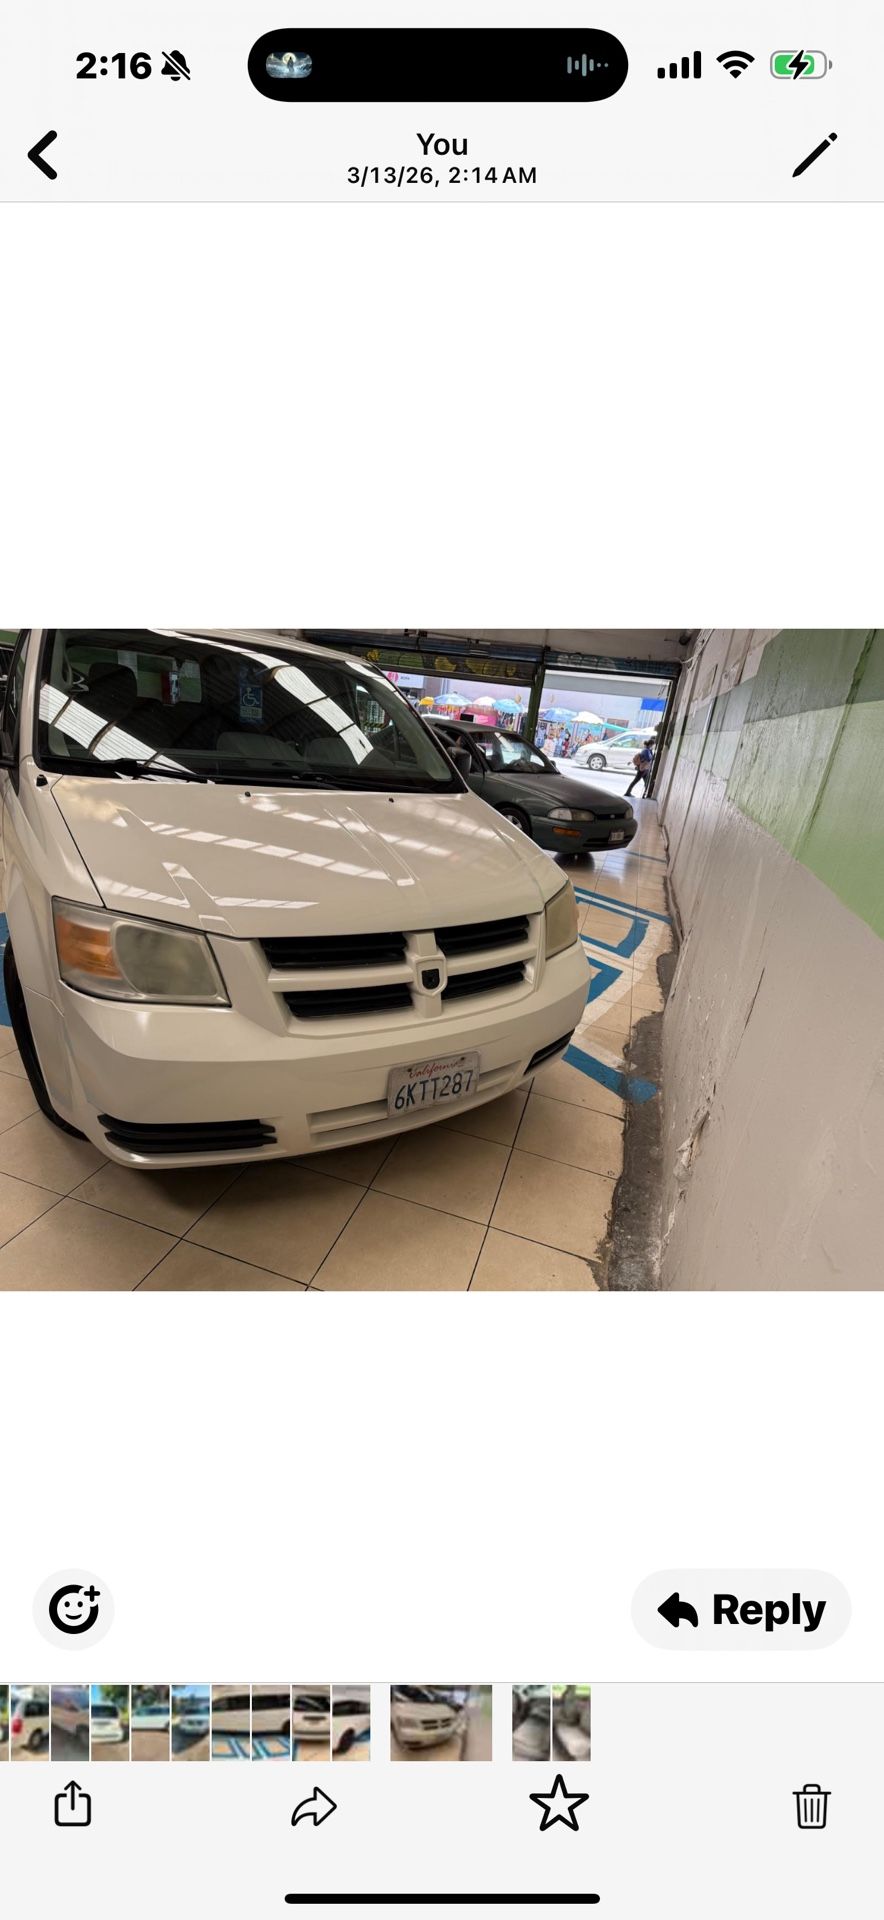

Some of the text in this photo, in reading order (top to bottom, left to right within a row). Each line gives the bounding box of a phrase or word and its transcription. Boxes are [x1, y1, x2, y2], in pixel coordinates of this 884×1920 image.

[75, 51, 152, 80] 2:16
[416, 132, 468, 156] You
[347, 165, 537, 188] 3/13/26, 2:14 AM
[409, 1061, 465, 1078] California
[394, 1069, 474, 1110] 6KTT287
[713, 1592, 827, 1633] Reply
